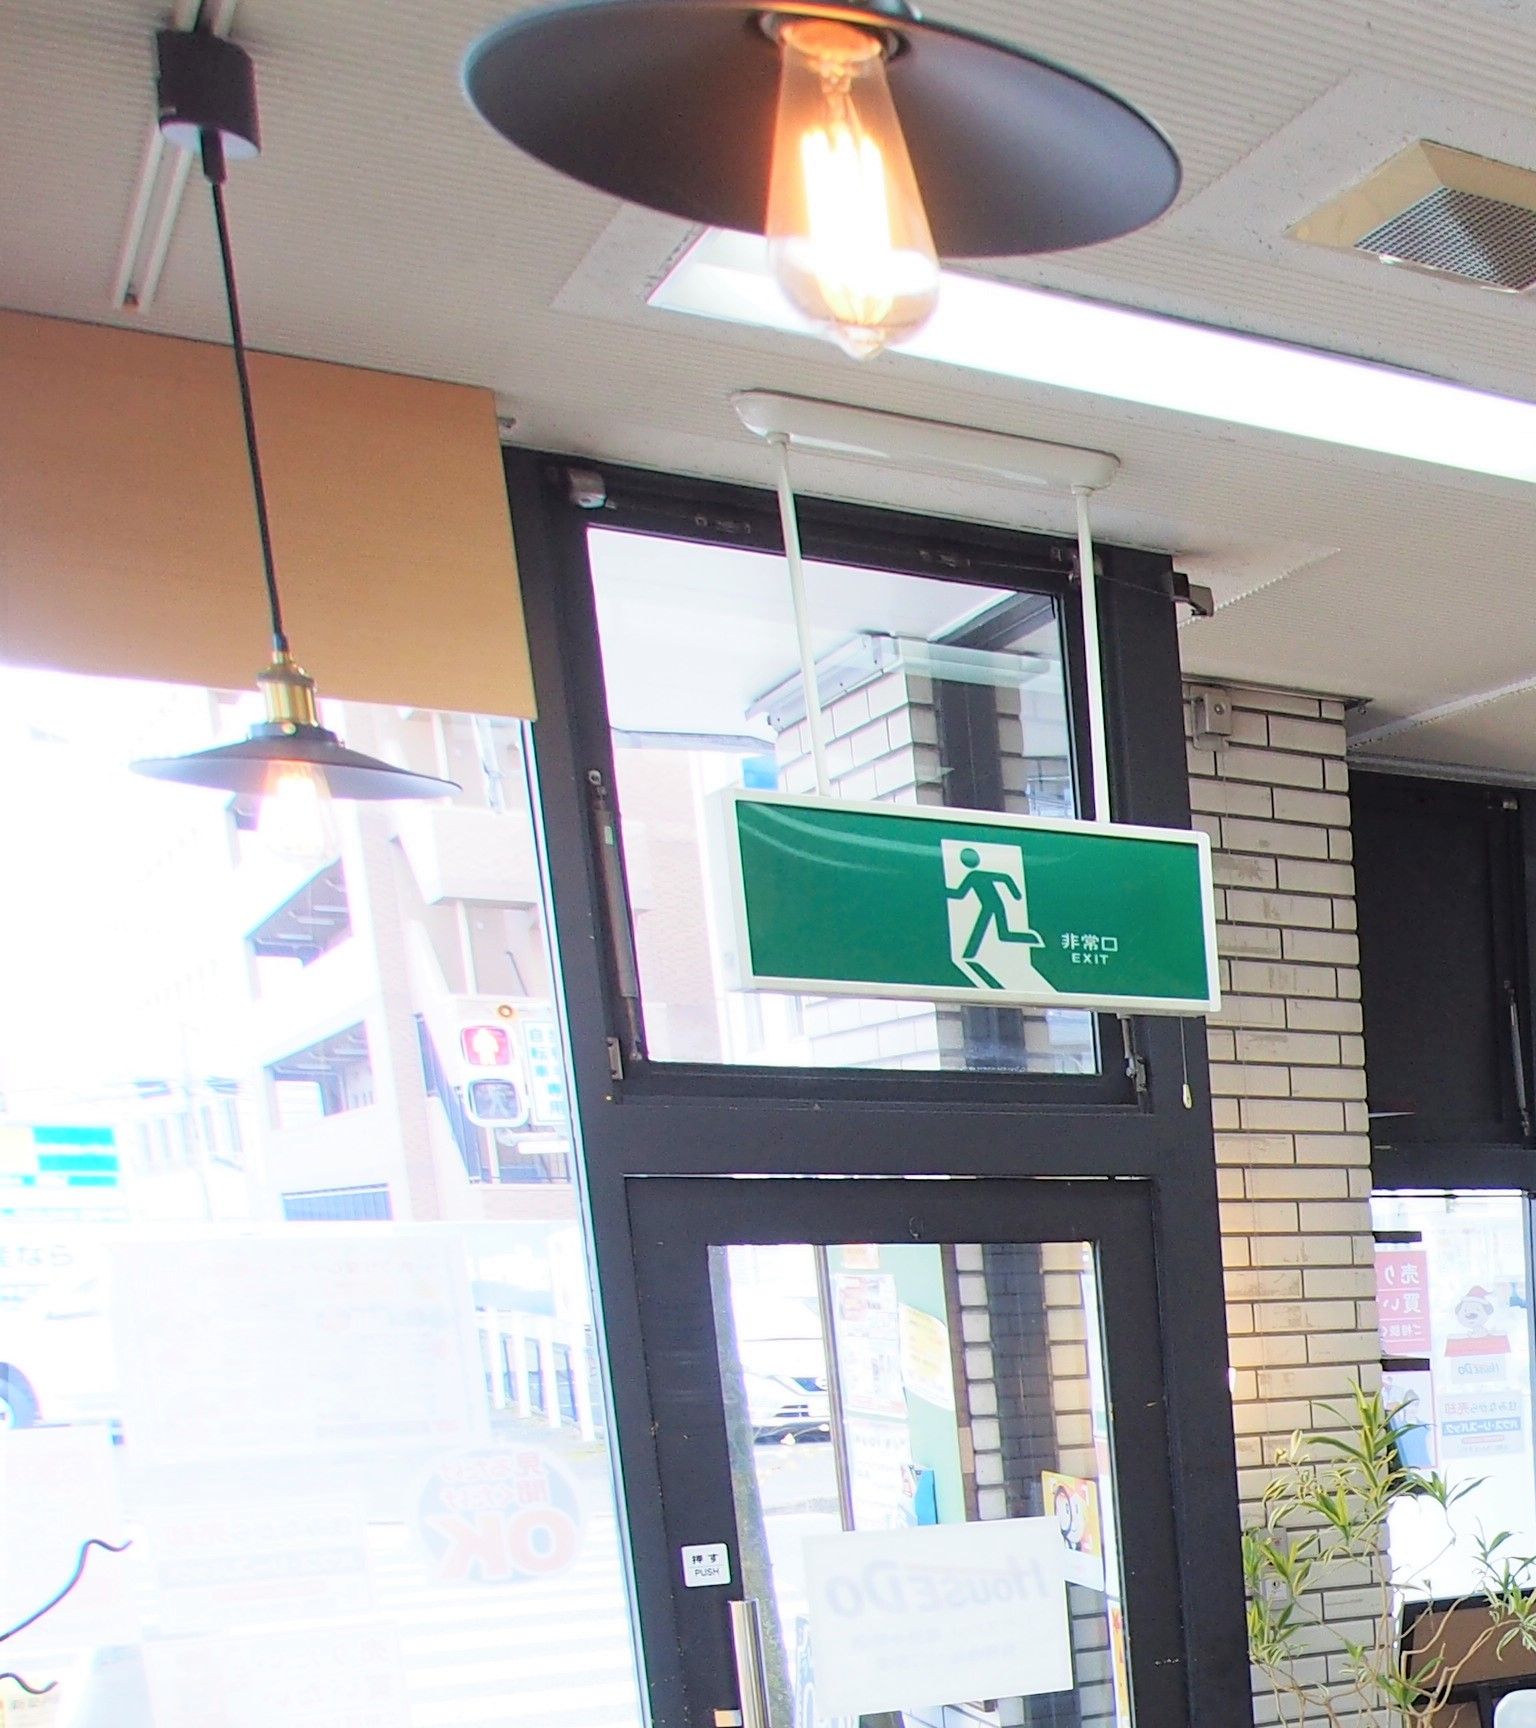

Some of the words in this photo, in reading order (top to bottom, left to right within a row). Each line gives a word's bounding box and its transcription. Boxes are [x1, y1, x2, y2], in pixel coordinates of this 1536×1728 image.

[1061, 932, 1118, 953] 非常口
[1070, 952, 1110, 967] EXIT
[690, 1550, 720, 1566] 押す
[693, 1566, 721, 1579] PUSH
